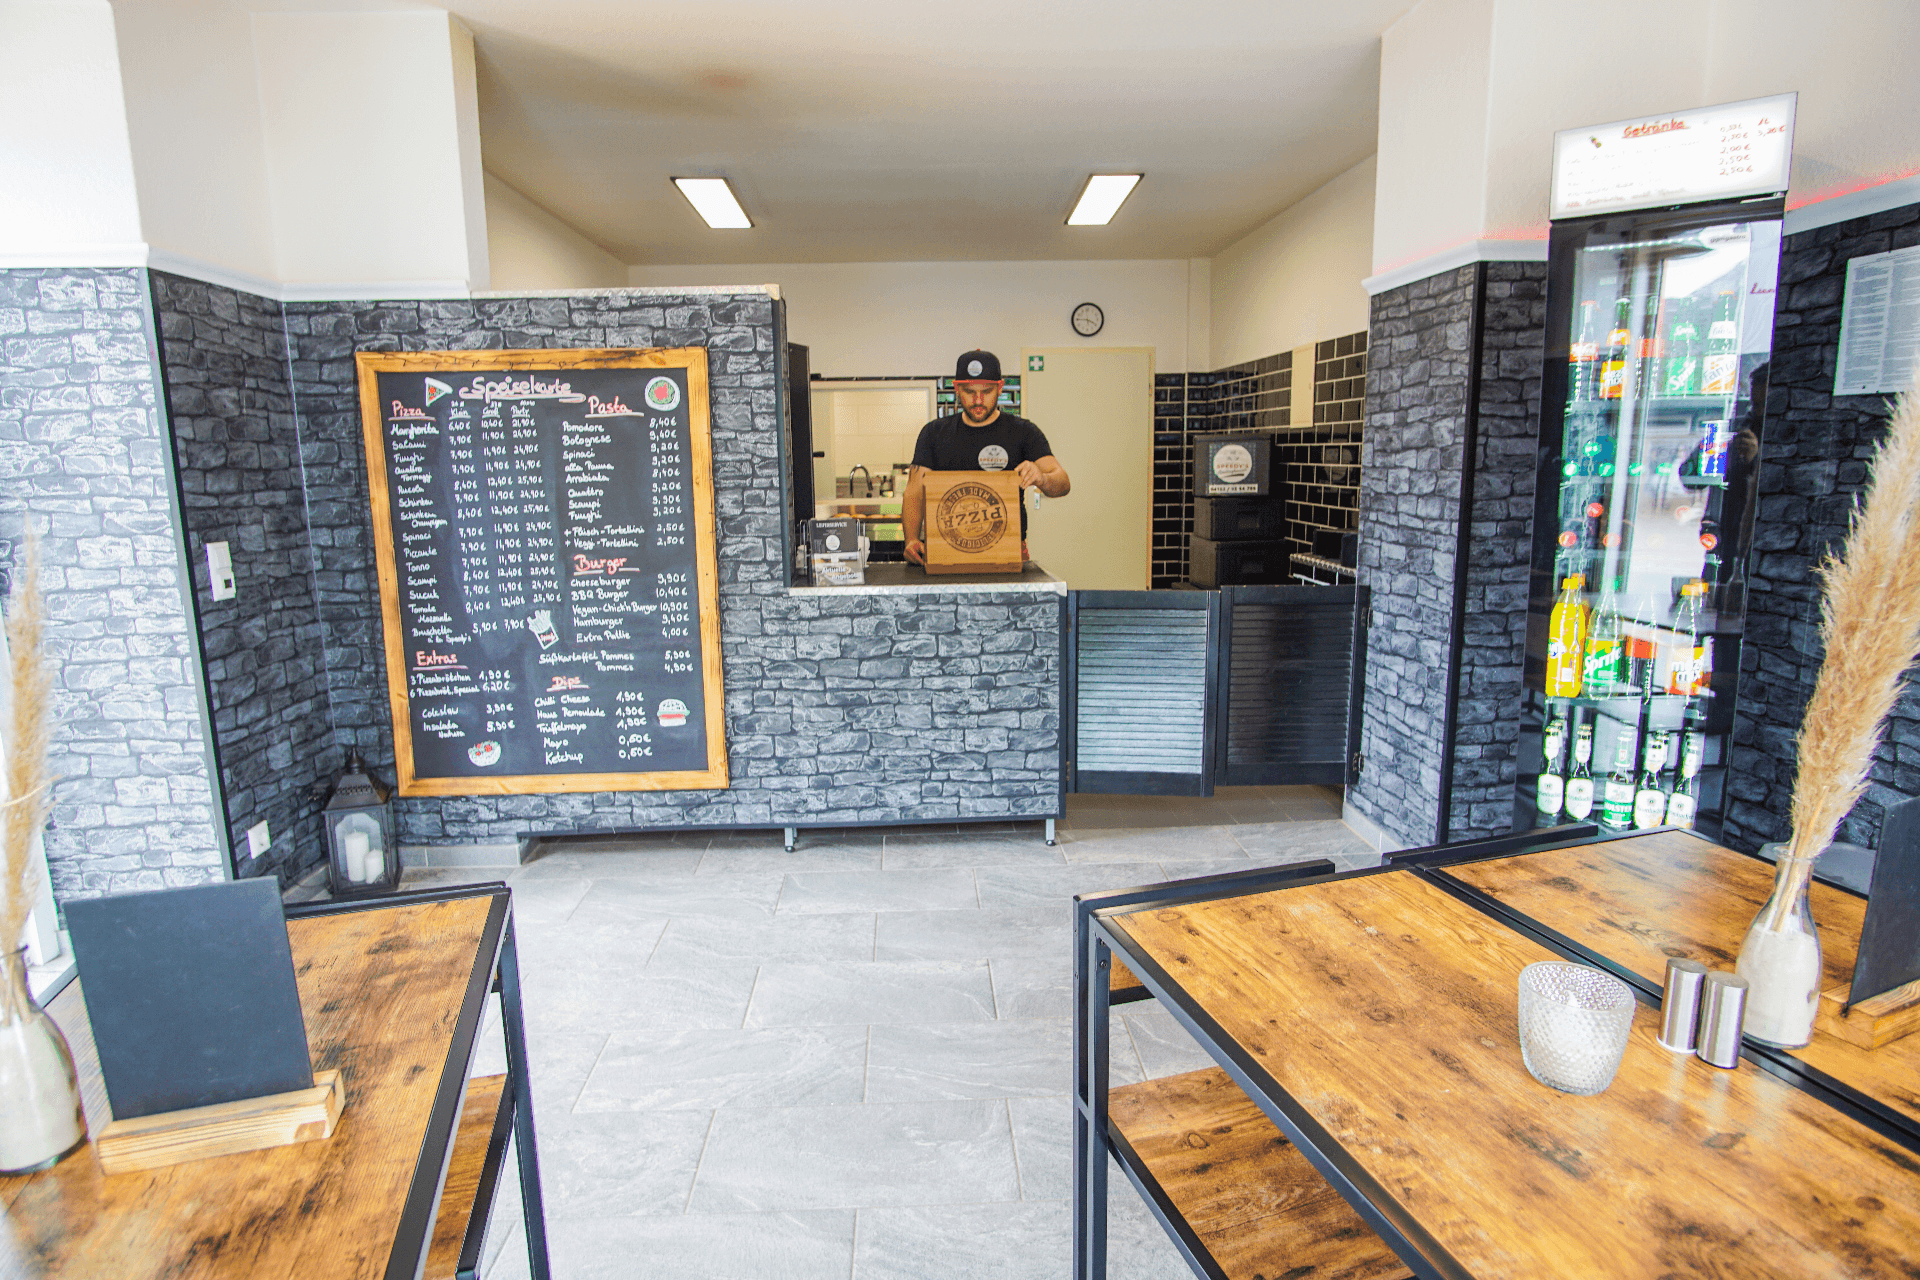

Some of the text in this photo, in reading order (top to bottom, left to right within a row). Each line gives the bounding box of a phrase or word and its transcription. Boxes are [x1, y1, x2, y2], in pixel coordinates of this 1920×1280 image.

[1623, 118, 1687, 137] Getränke
[471, 375, 572, 404] Speisekarte
[392, 400, 426, 417] Pizza
[588, 395, 632, 414] Pasta
[649, 416, 677, 429] 8,40€
[392, 439, 426, 451] Salami
[562, 429, 677, 447] Bolognese 9,40€
[394, 452, 425, 466] Funghi
[562, 441, 680, 462] Spinaci 9,20€
[652, 455, 681, 467] 9,20€
[394, 465, 423, 475] Quattro
[565, 468, 681, 484] Arrabiata 8,40€
[567, 481, 681, 498] Quattro 9,20€
[399, 497, 433, 508] Schinken
[568, 495, 681, 511] Scampi 9,90€
[400, 509, 437, 521] Schinken
[568, 506, 682, 523] Funghi 9,20€
[940, 506, 1002, 529] PIZZA
[656, 523, 685, 535] 2,50€
[402, 530, 431, 546] Spinaci
[656, 536, 685, 547] 2,50€
[403, 545, 438, 558] Piccante
[406, 562, 431, 573] Tonno
[573, 554, 627, 575] Burger
[407, 574, 438, 587] Scampi
[570, 573, 687, 590] Cheeseburger 9,90€
[409, 589, 440, 600] Sucuk
[570, 586, 688, 602] BBQ Burger 10,40€
[408, 603, 436, 614] Tomate
[631, 601, 658, 615] Burger
[660, 602, 689, 613] 10,90€
[573, 613, 690, 629] Hamburger 9,40€
[577, 627, 689, 643] Extra Pattie 4,00€
[416, 650, 458, 666] Extras
[538, 650, 691, 666] Süßkartoffel Pommes 5,90€
[1584, 646, 1623, 676] Sprite
[595, 661, 694, 674] Pommes 4,90€
[410, 675, 417, 686] 3
[551, 675, 581, 690] Dips
[410, 689, 415, 698] 6
[534, 691, 645, 708] Chilli Cheese 1,90€
[422, 703, 514, 719] Coleslaw 3,90€
[536, 706, 646, 720] Haus Remoulade 1,90€
[423, 719, 516, 733] Insalata 5,90€
[536, 721, 587, 736] Trüffelmayo
[543, 736, 569, 750] Mayo
[545, 751, 584, 765] Ketchup
